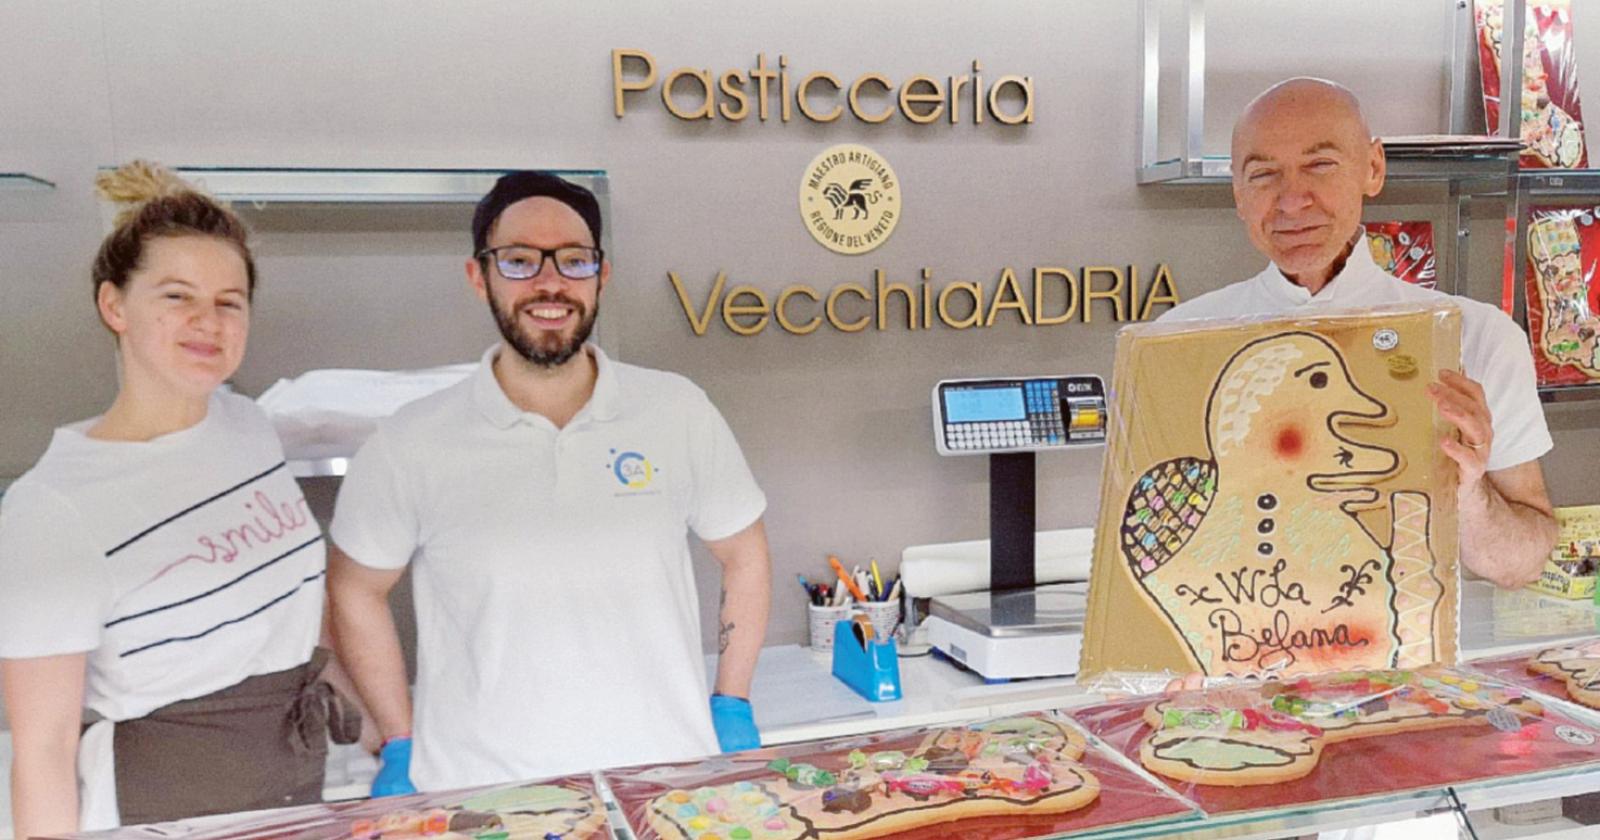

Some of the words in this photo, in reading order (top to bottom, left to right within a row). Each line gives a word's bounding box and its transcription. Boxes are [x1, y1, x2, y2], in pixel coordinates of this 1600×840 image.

[611, 48, 1035, 125] Pasticceria
[808, 153, 846, 190] MAESTRO
[848, 151, 894, 190] ARTIGIANO
[810, 210, 845, 246] REGIONE
[846, 233, 865, 248] DEL
[863, 210, 894, 243] VENETO
[666, 263, 1180, 335] VecchiaADRIA
